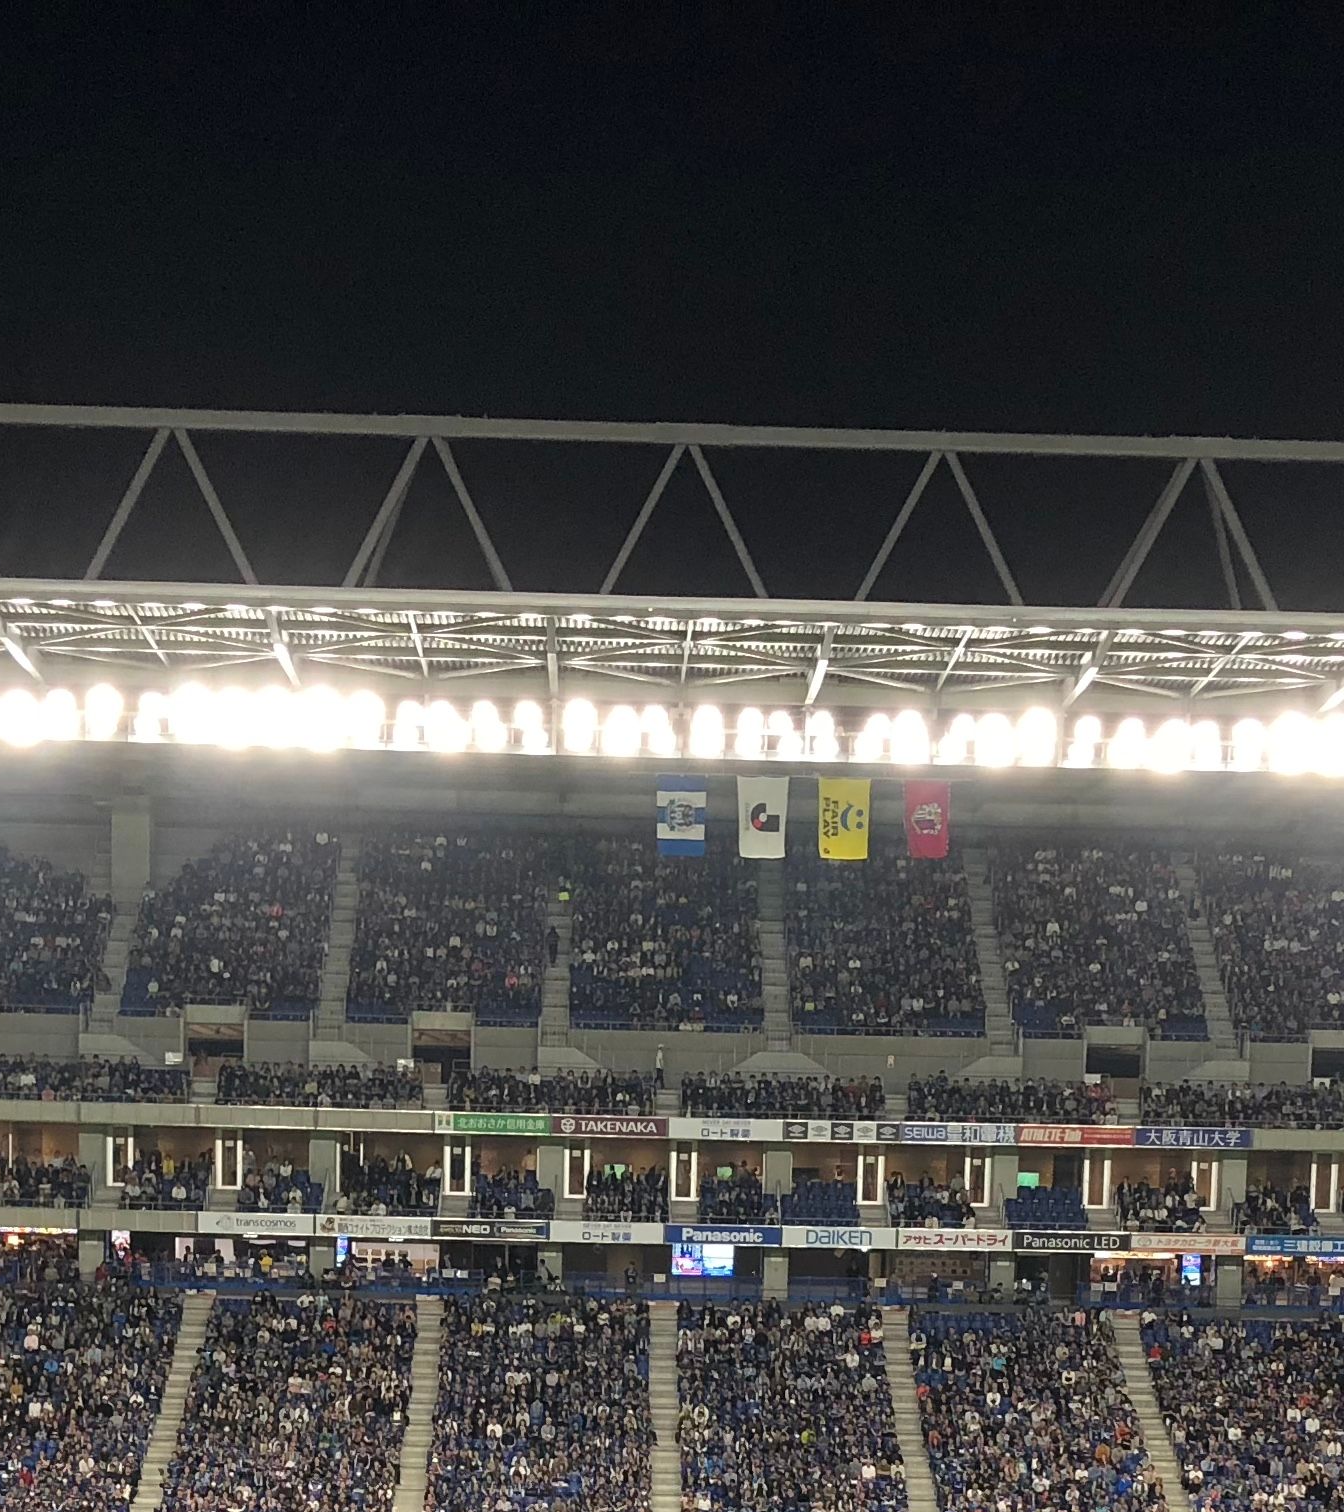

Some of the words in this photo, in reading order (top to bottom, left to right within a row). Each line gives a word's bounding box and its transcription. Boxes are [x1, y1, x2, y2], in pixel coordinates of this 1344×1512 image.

[831, 800, 840, 837] FAIR
[578, 1120, 657, 1133] TAKENAKA
[1145, 1129, 1240, 1147] 大阪青山大学
[235, 1217, 296, 1228] transcosmos
[462, 1224, 491, 1235] NEO
[681, 1227, 764, 1243] Panasonic
[1023, 1234, 1090, 1248] Panasonic
[1094, 1236, 1120, 1249] LED
